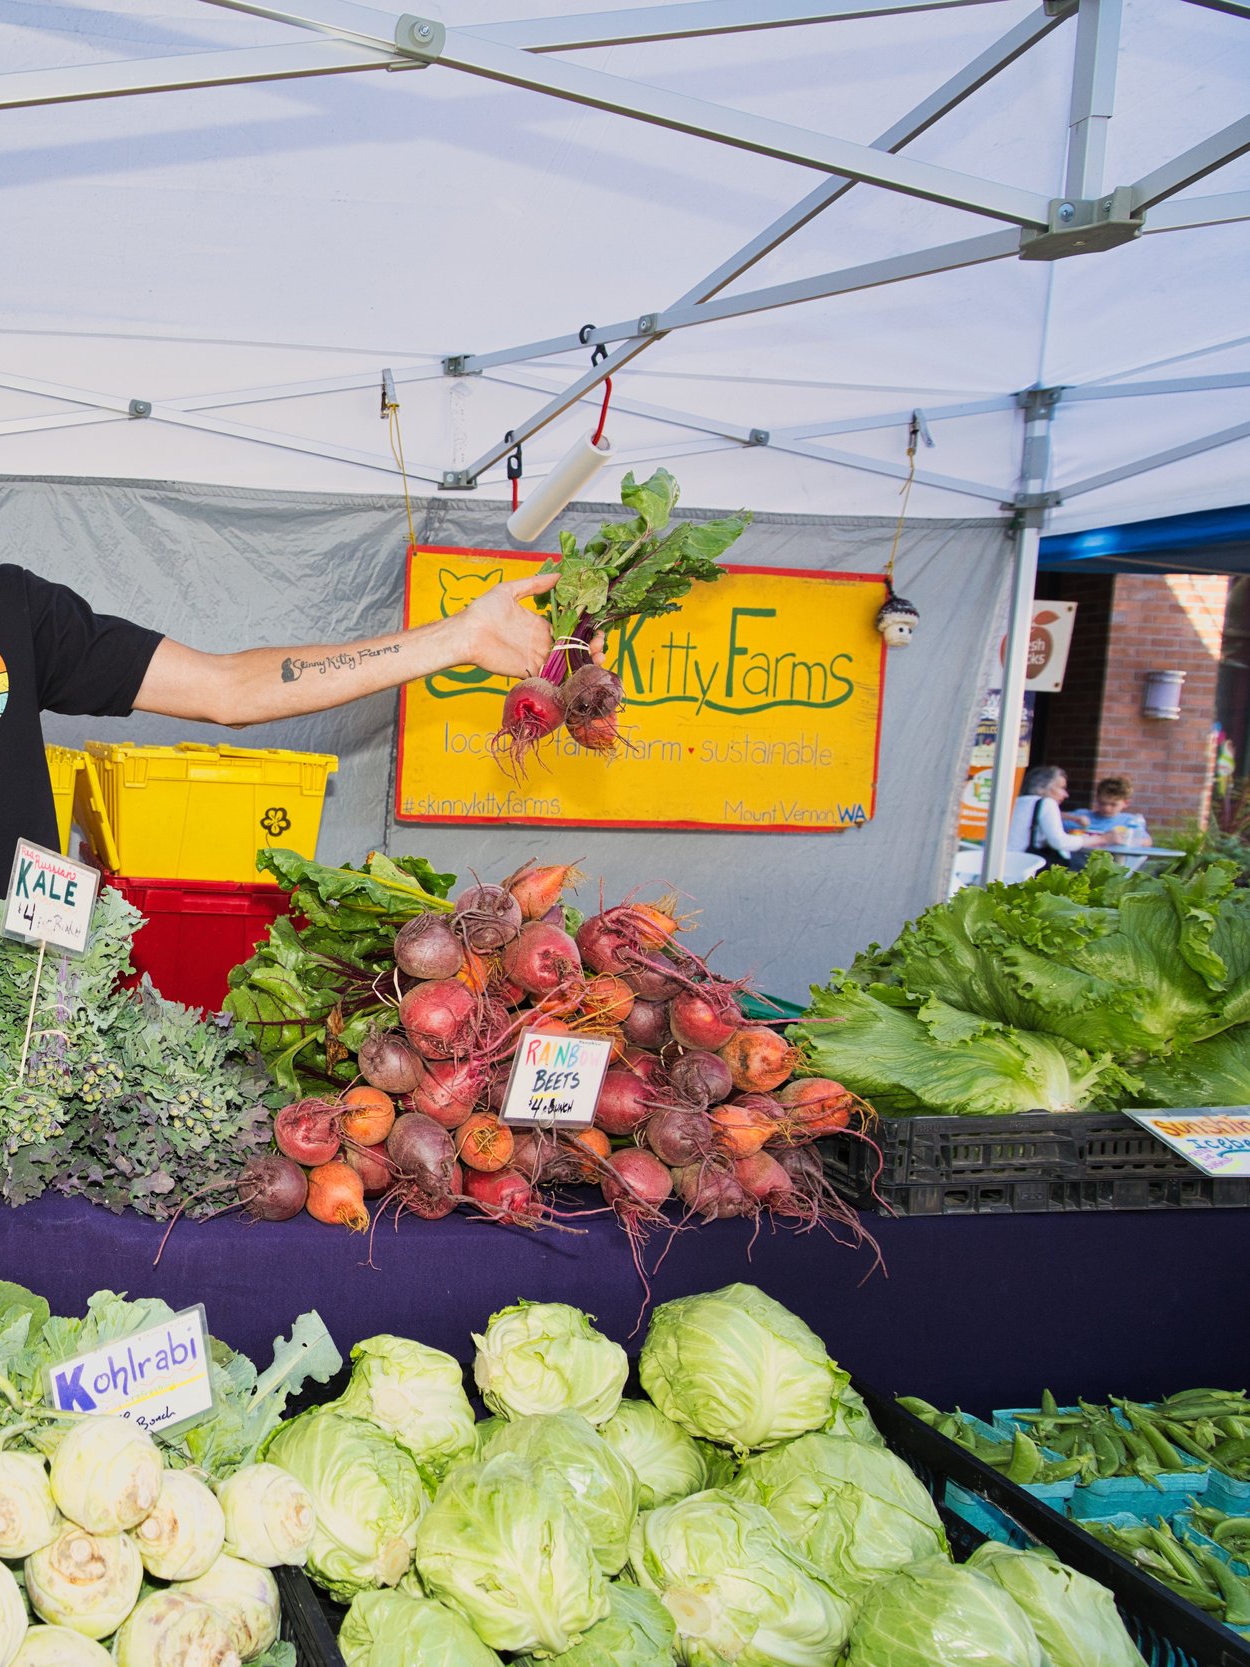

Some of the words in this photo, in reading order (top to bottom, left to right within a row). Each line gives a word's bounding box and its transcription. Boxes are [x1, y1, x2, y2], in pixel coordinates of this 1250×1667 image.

[292, 658, 326, 681] Skinny
[326, 653, 356, 670] Kitty
[356, 643, 402, 665] Farms
[618, 611, 720, 717] Kitty
[725, 607, 854, 700] Farms
[700, 732, 833, 767] sustainable
[403, 790, 561, 817] #skinnykittyfarms
[724, 800, 776, 823] Mount
[778, 801, 837, 825] Vernon,
[837, 803, 867, 824] WA
[15, 857, 78, 907] KALE
[34, 854, 77, 881] Russian
[532, 1068, 581, 1093] BEETS
[528, 1095, 544, 1119] $4
[548, 1097, 575, 1115] BUNCH
[54, 1326, 198, 1412] Kohlrabi
